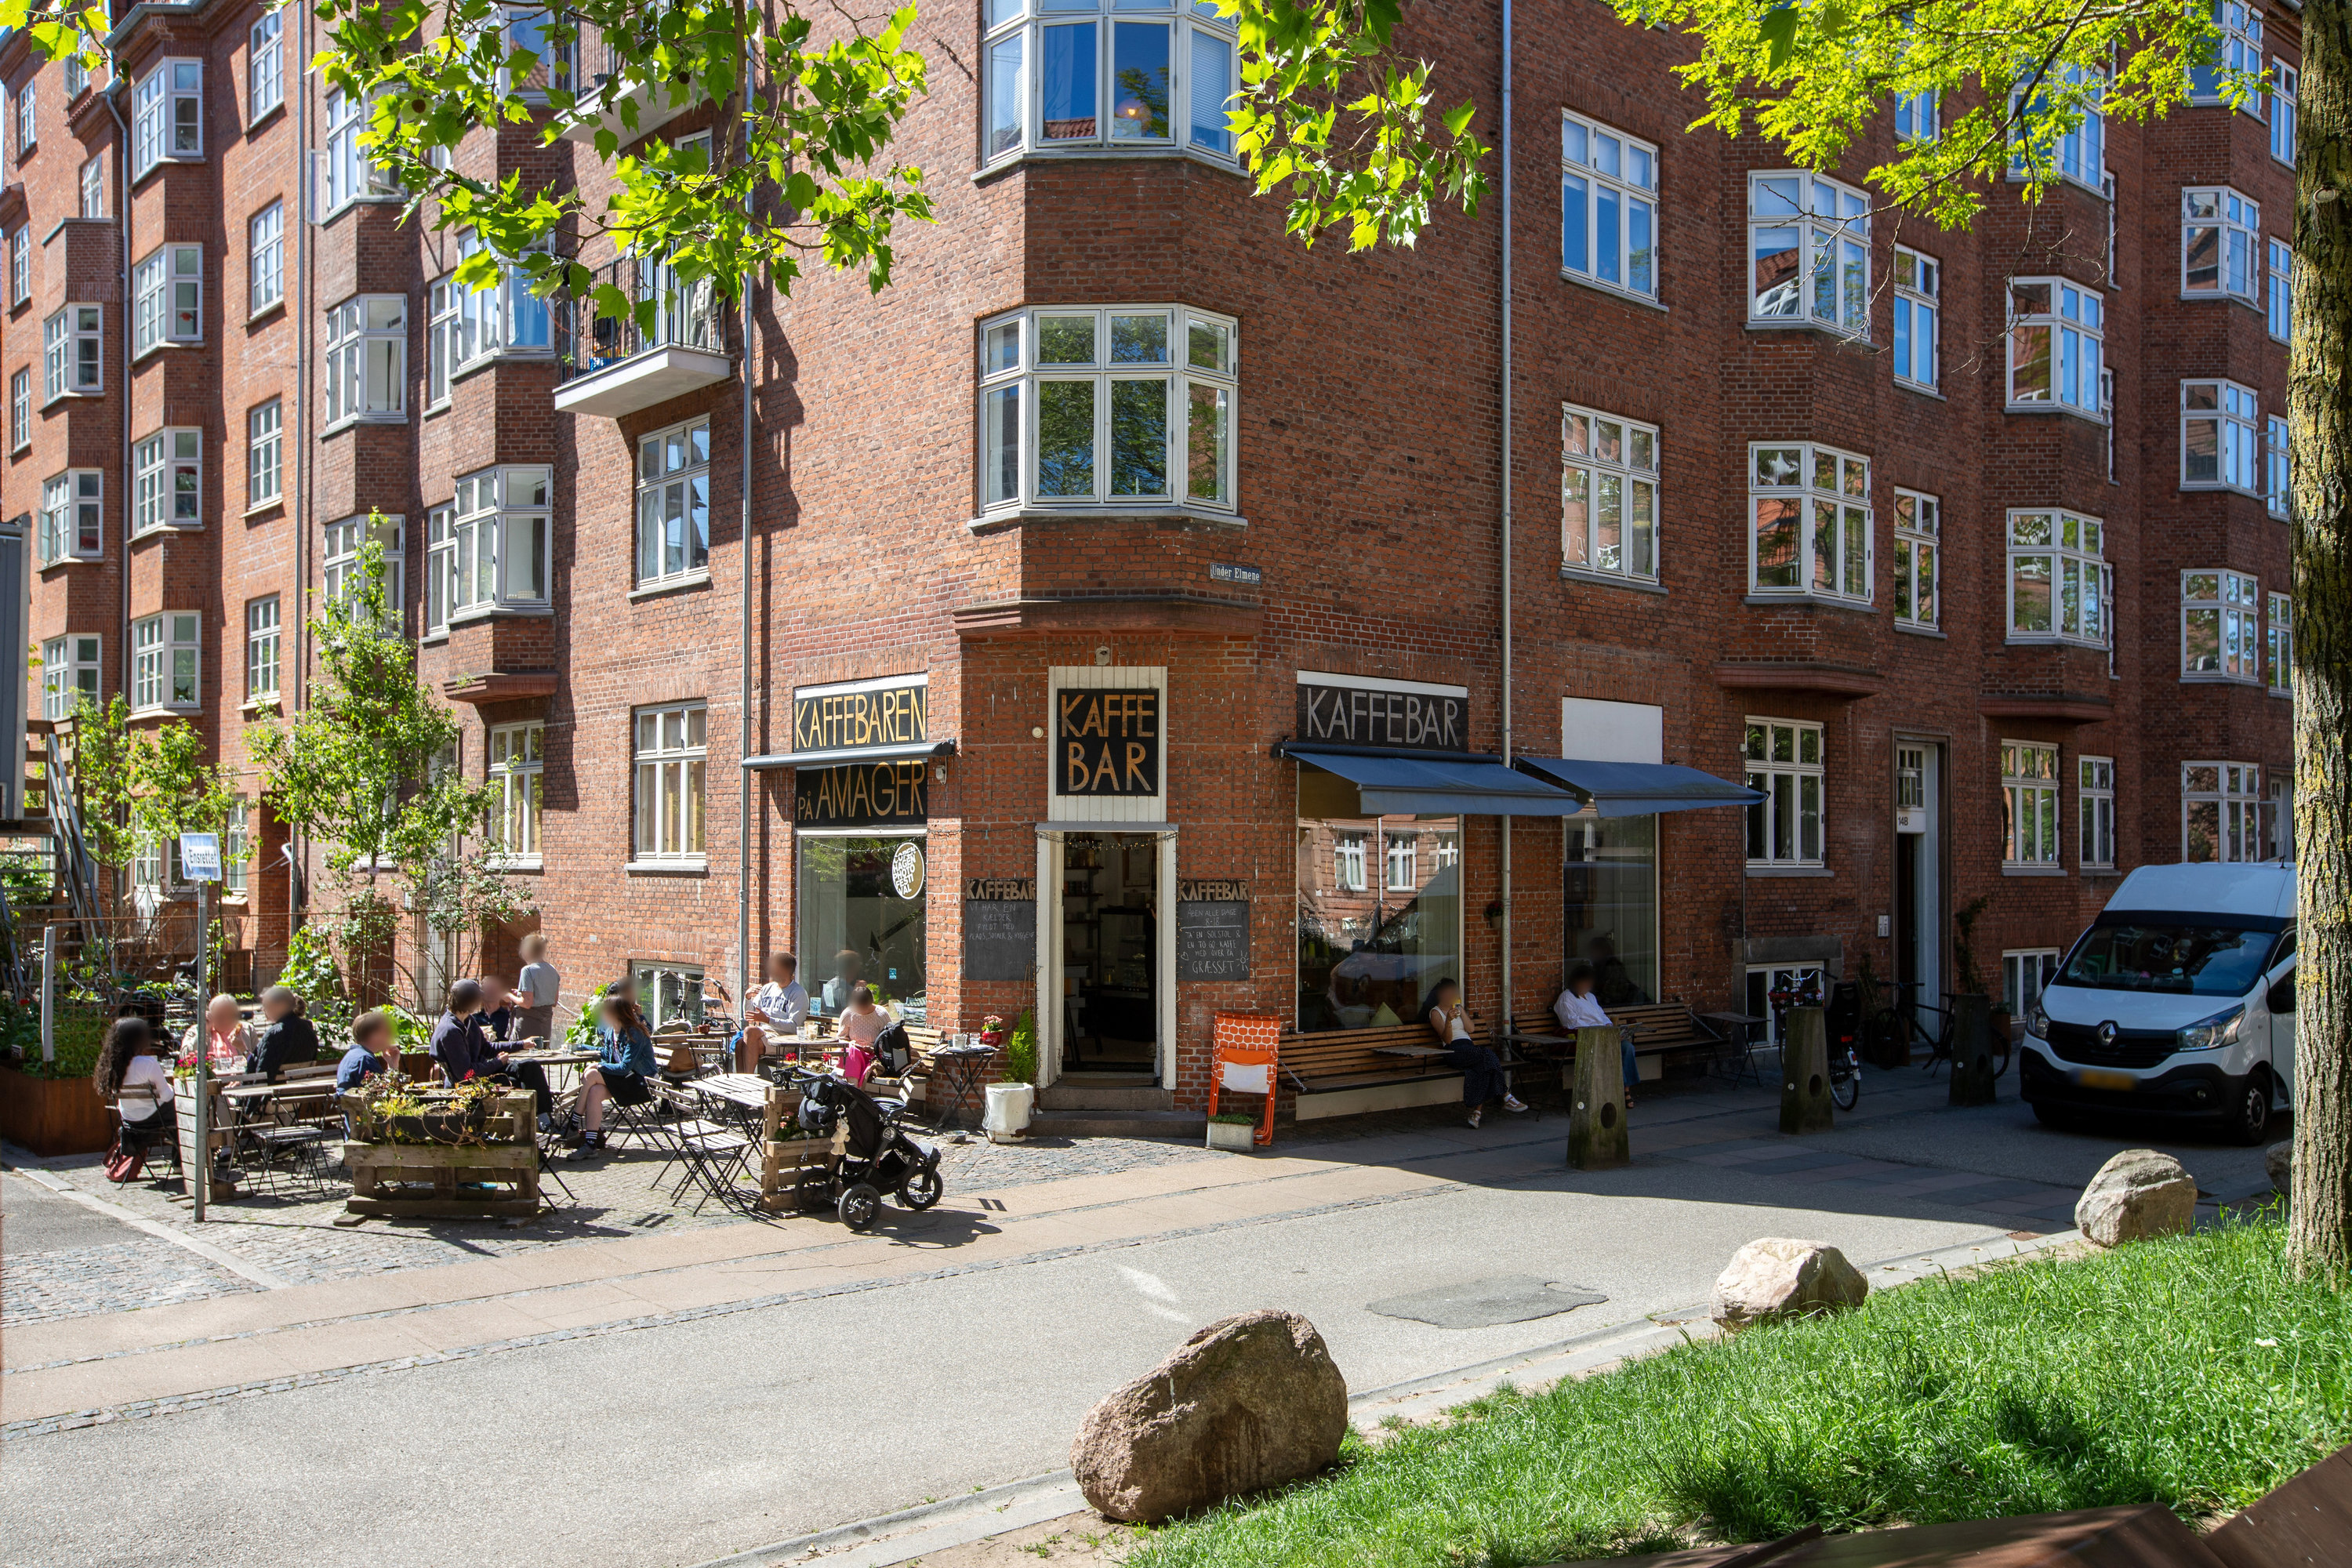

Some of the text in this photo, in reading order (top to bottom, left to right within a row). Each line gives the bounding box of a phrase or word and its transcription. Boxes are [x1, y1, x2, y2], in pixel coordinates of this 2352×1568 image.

[1212, 564, 1260, 580] Under Elmene
[795, 688, 927, 749] KAFFEBAREN
[1061, 695, 1155, 738] KAFFE
[1307, 688, 1459, 746] KAFFEBAR
[1068, 741, 1152, 792] BAR
[798, 760, 925, 821] PÅ AMAGER
[189, 848, 217, 865] Ensrettet
[894, 854, 916, 873] HAGEN
[894, 864, 916, 880] PHOTO
[895, 873, 914, 890] FESTI
[898, 884, 912, 895] VAL
[966, 880, 1036, 901] KAFFEBAR
[1178, 880, 1249, 902] KAFFEBAR
[982, 903, 1000, 913] HAR
[1004, 903, 1016, 913] EN
[1221, 908, 1237, 916] DAGE
[1004, 923, 1015, 931] MED
[1205, 917, 1220, 926] 8-18
[1198, 940, 1207, 949] TO
[1192, 960, 1235, 975] GRÆSSET
